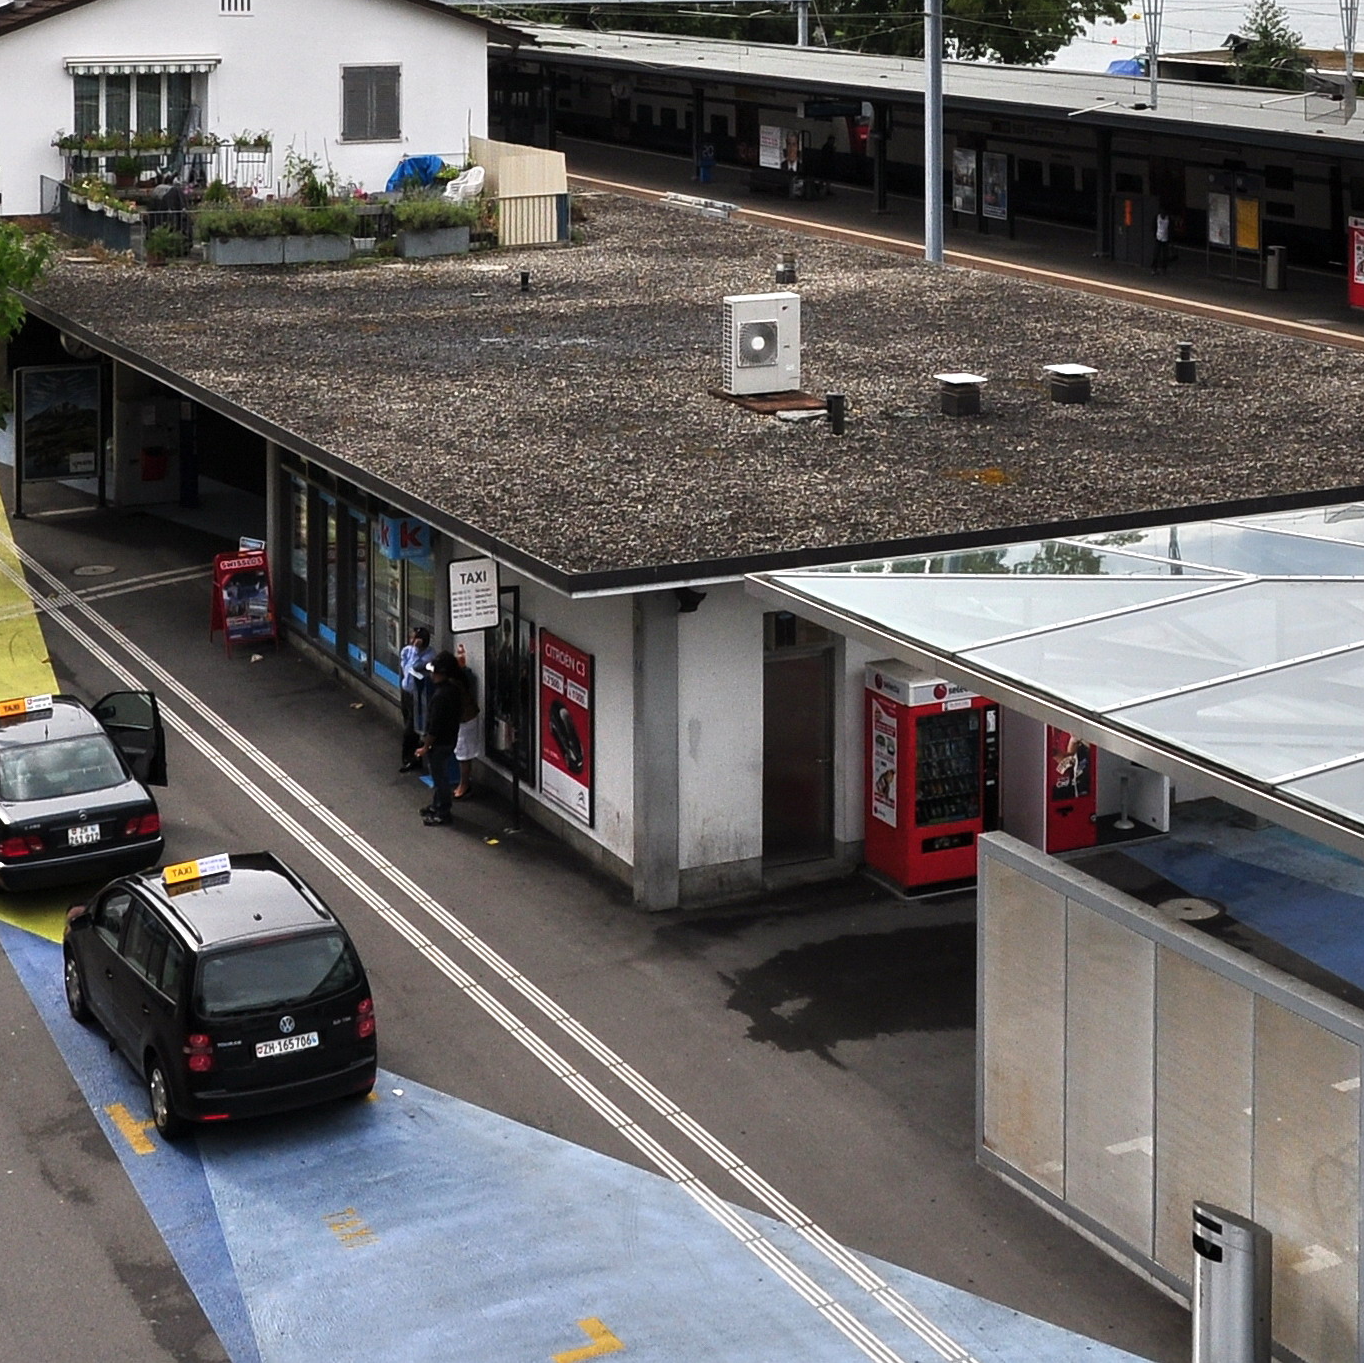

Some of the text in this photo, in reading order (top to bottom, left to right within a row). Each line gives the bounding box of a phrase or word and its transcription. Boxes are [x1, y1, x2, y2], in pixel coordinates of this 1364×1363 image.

[221, 556, 263, 569] SWISSLOS
[459, 570, 487, 585] TAXI
[575, 660, 586, 677] C3
[3, 703, 21, 712] TAXI
[171, 866, 193, 878] TAXI
